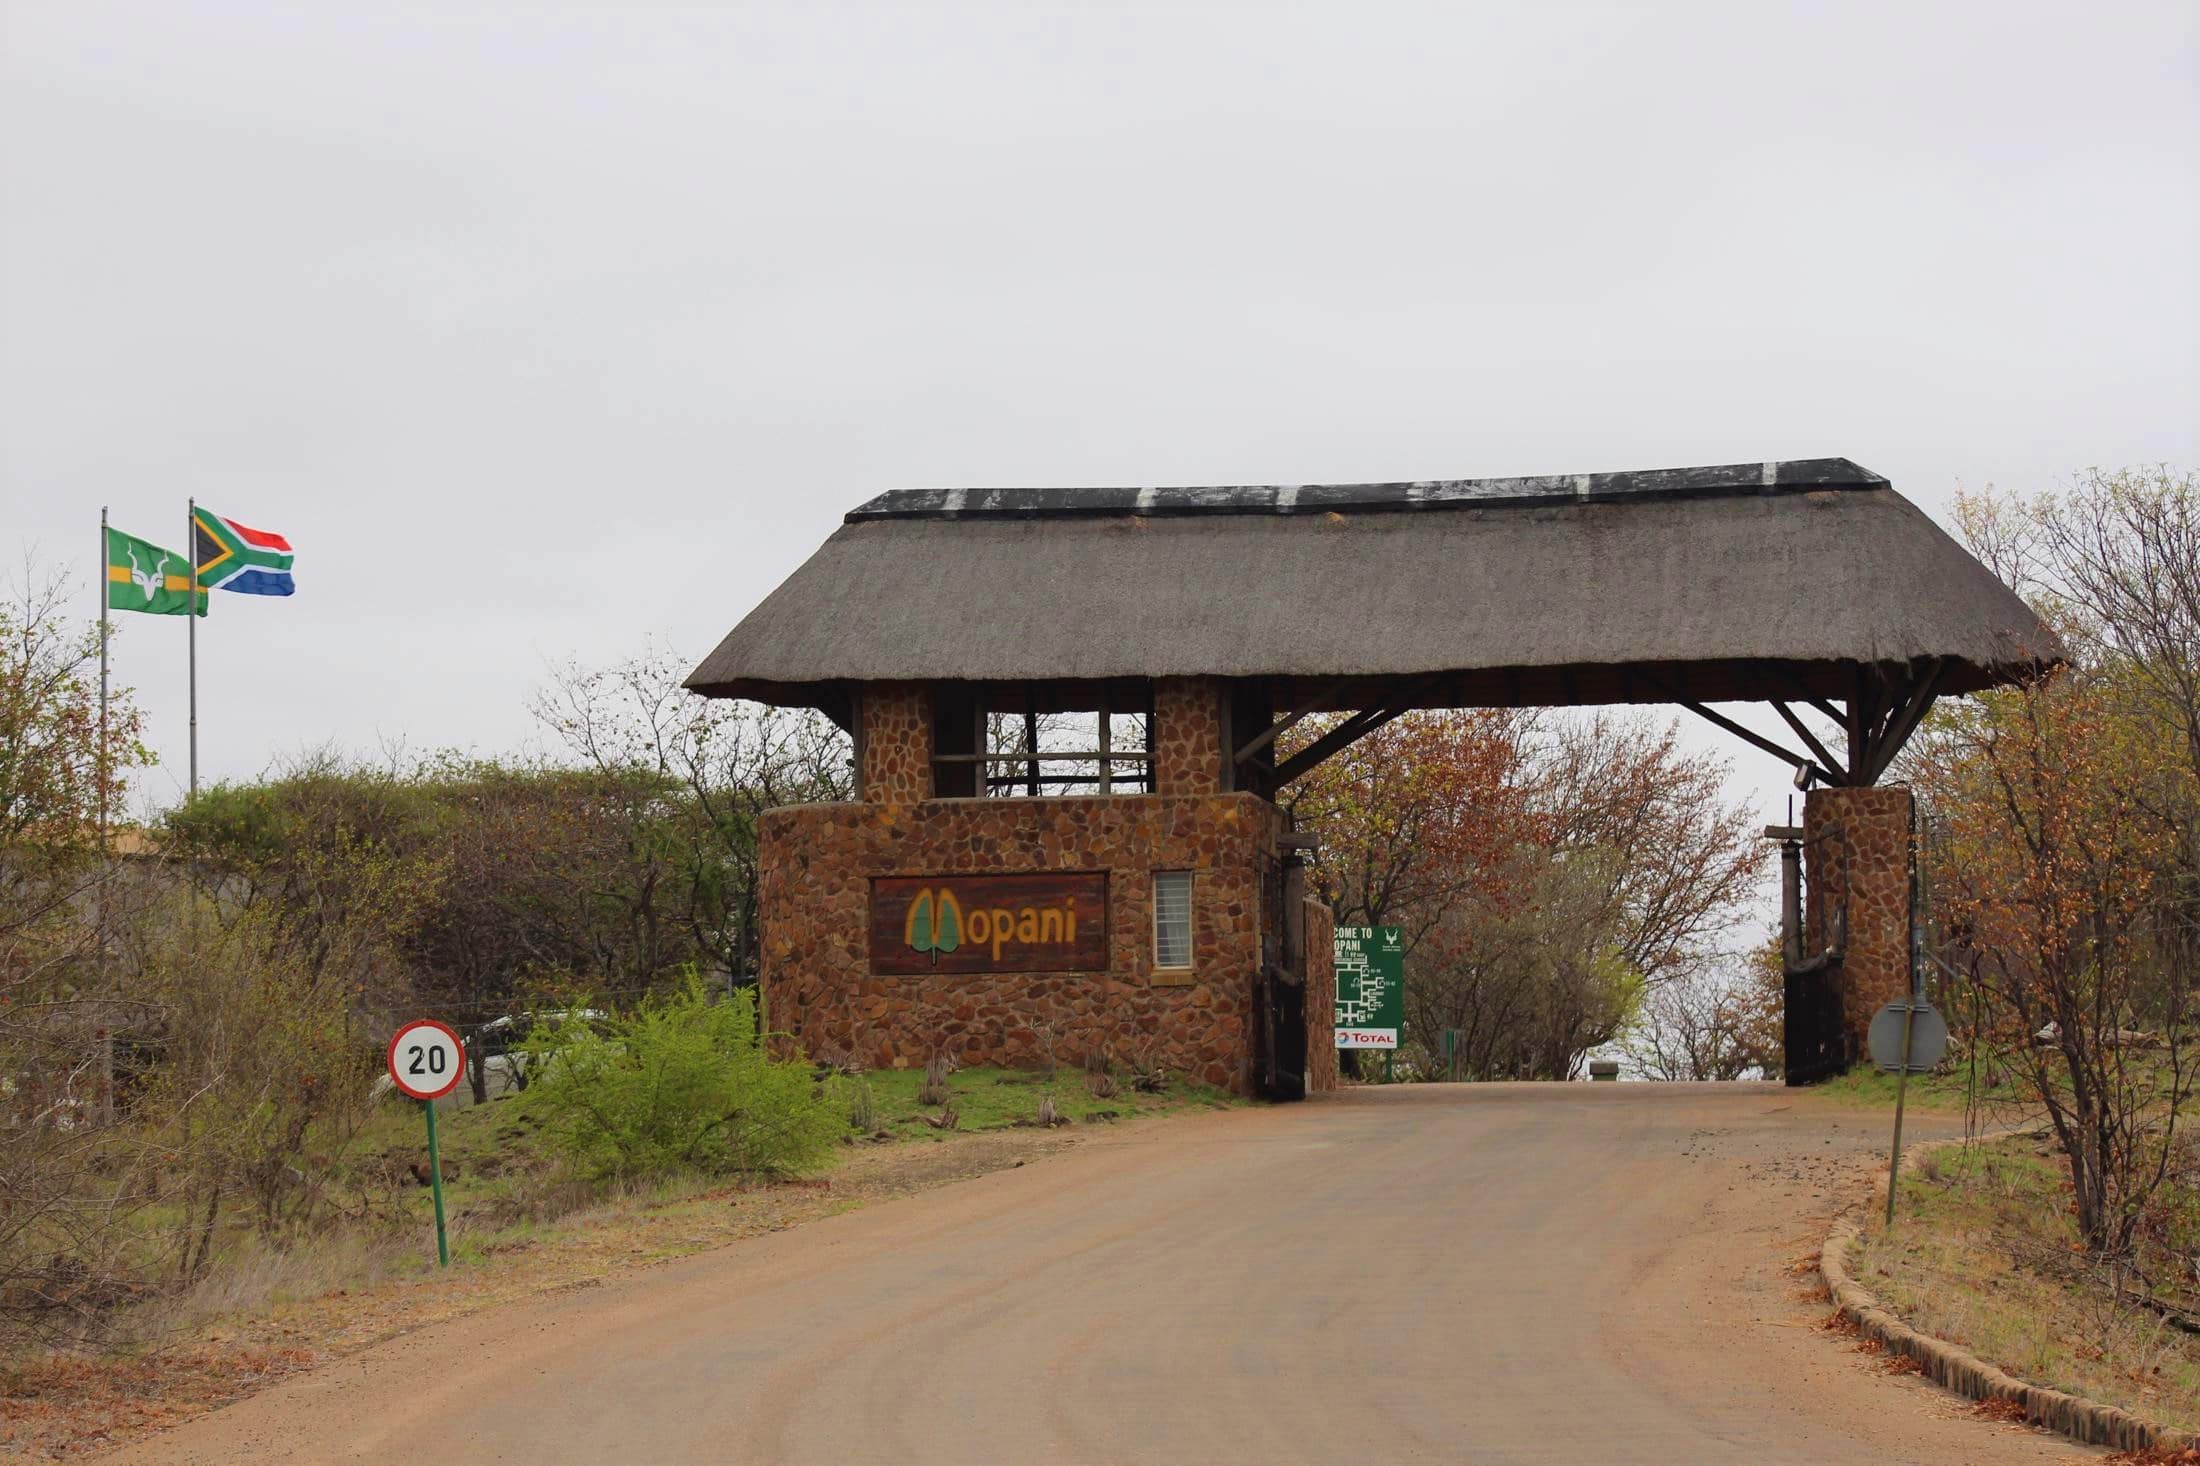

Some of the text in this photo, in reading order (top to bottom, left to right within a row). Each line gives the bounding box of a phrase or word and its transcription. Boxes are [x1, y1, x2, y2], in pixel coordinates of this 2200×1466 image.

[904, 887, 1077, 961] Mopani
[1361, 927, 1373, 939] TO
[1352, 1032, 1394, 1043] TOTAL
[408, 1045, 446, 1075] 20
